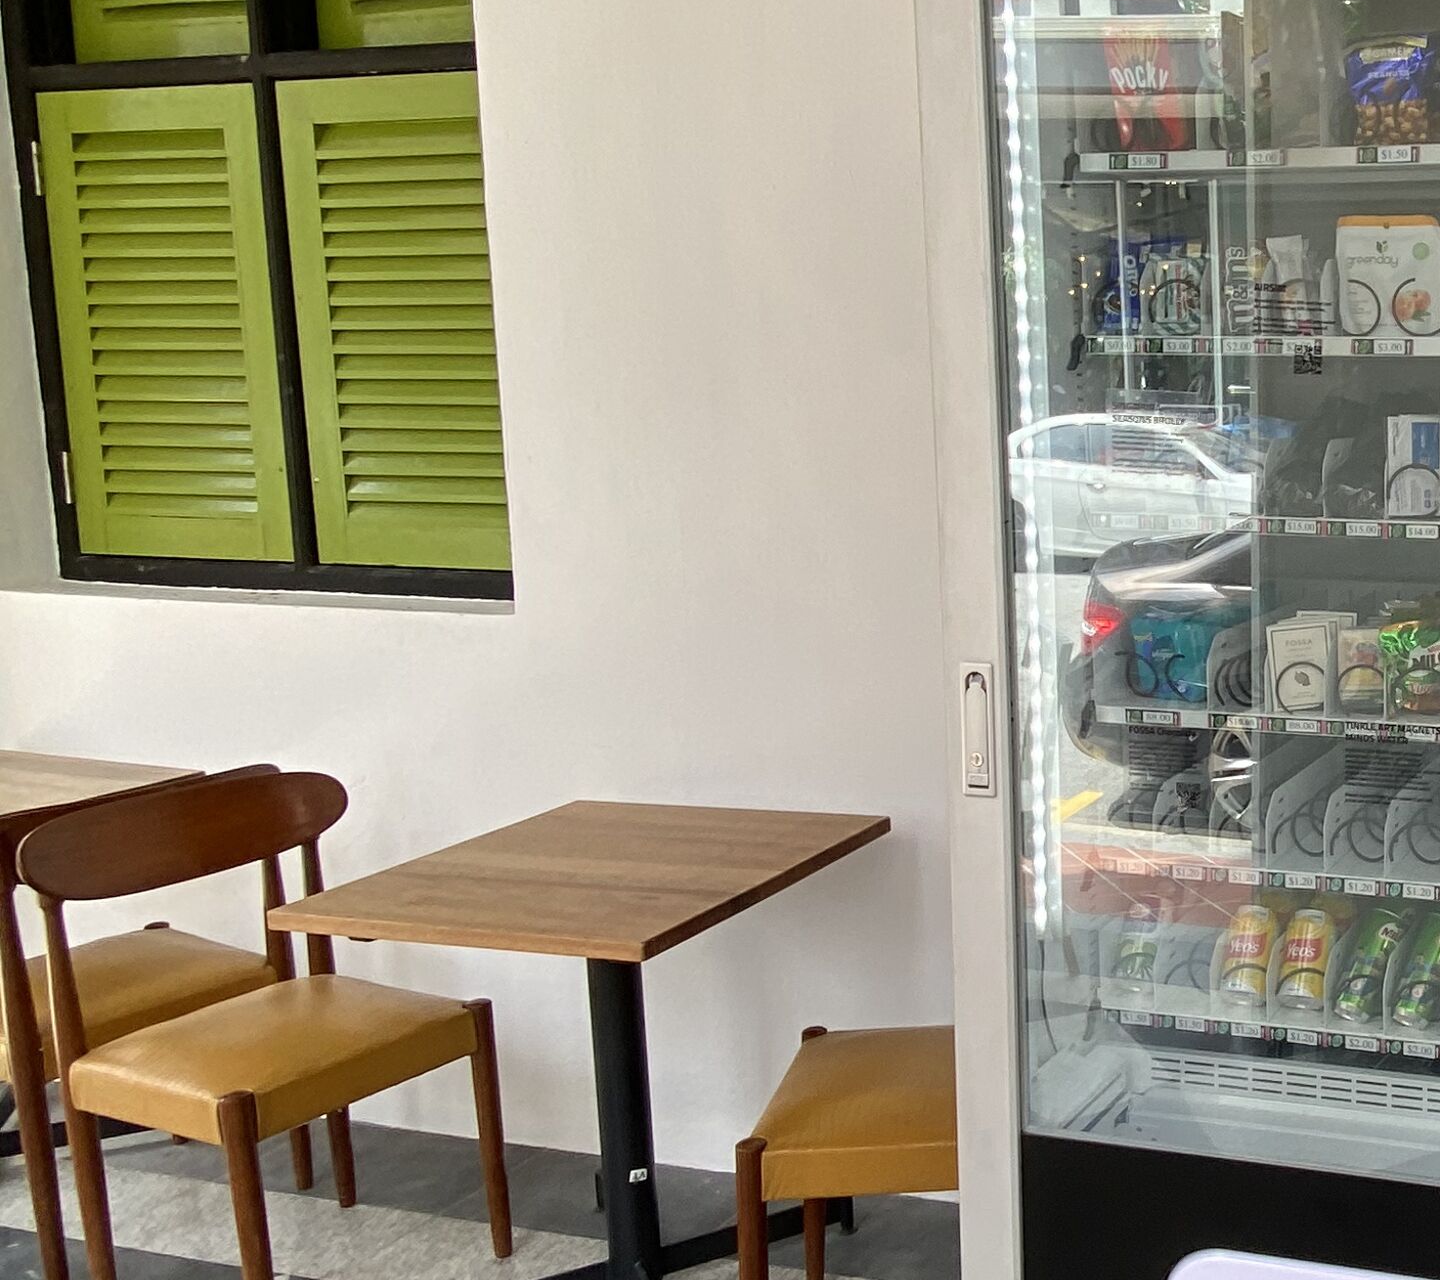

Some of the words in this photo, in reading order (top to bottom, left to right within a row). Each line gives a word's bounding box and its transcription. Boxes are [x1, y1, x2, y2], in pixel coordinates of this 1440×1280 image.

[1381, 149, 1408, 160] $1.50
[1288, 876, 1313, 886] $1.20
[1348, 881, 1373, 892] $1.20
[1406, 886, 1432, 897] $1.20
[1290, 1032, 1315, 1043] $1.20
[1349, 1038, 1374, 1049] $2.00
